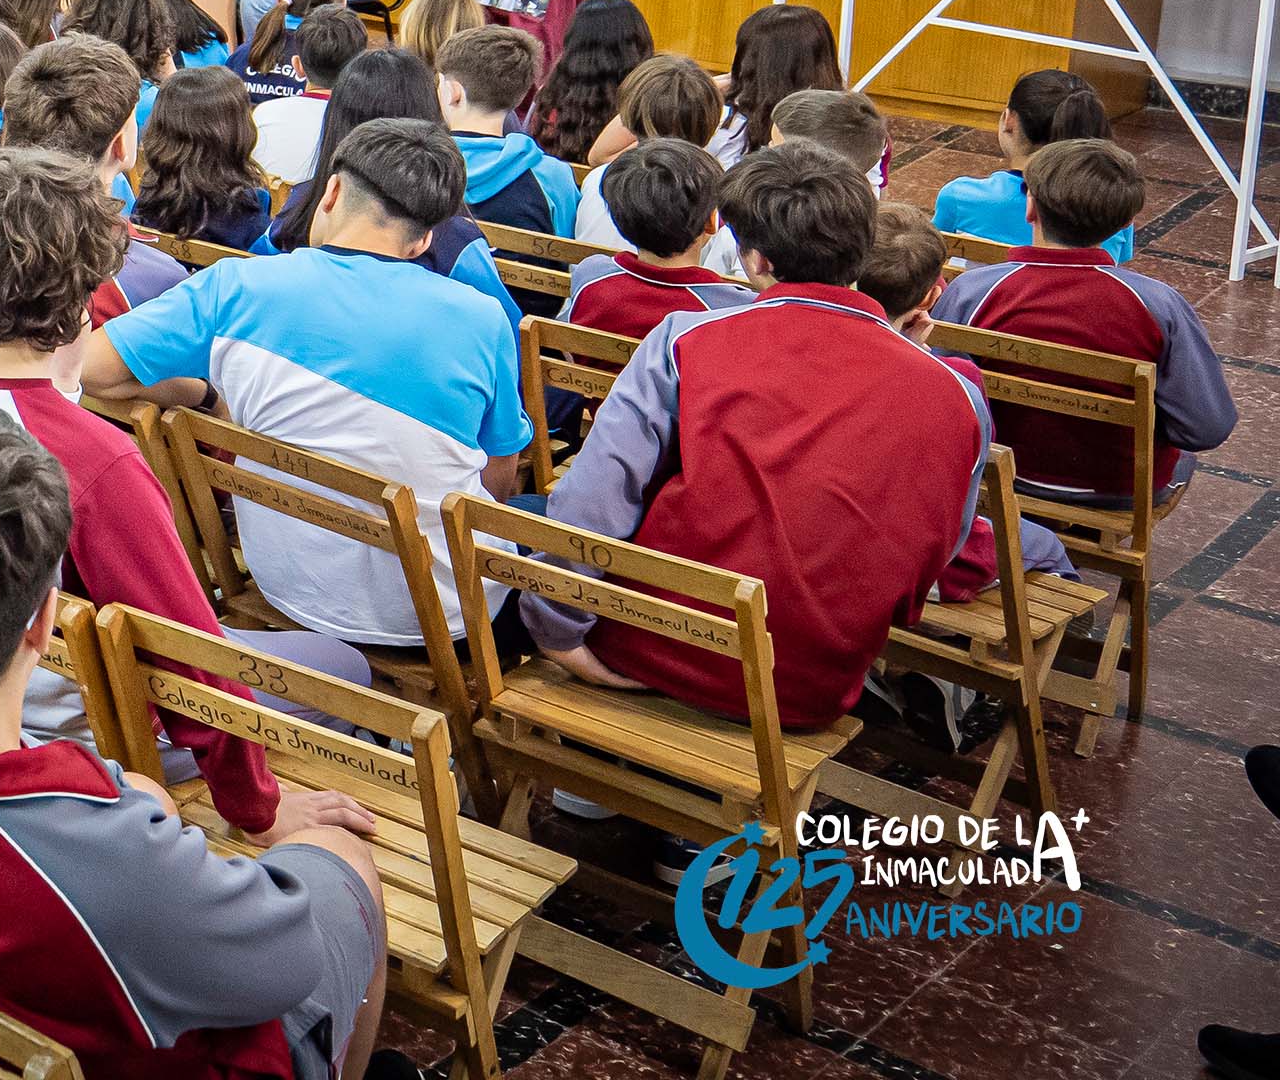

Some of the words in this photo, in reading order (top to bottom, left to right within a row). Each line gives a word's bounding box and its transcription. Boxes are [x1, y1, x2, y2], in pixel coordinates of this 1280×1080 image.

[532, 238, 561, 258] 56
[547, 367, 608, 394] Colegio
[270, 447, 310, 475] 149
[212, 468, 264, 501] Colegio
[568, 534, 613, 569] 90
[485, 557, 556, 593] Colegio
[239, 654, 290, 695] 33
[148, 675, 233, 726] Colegio
